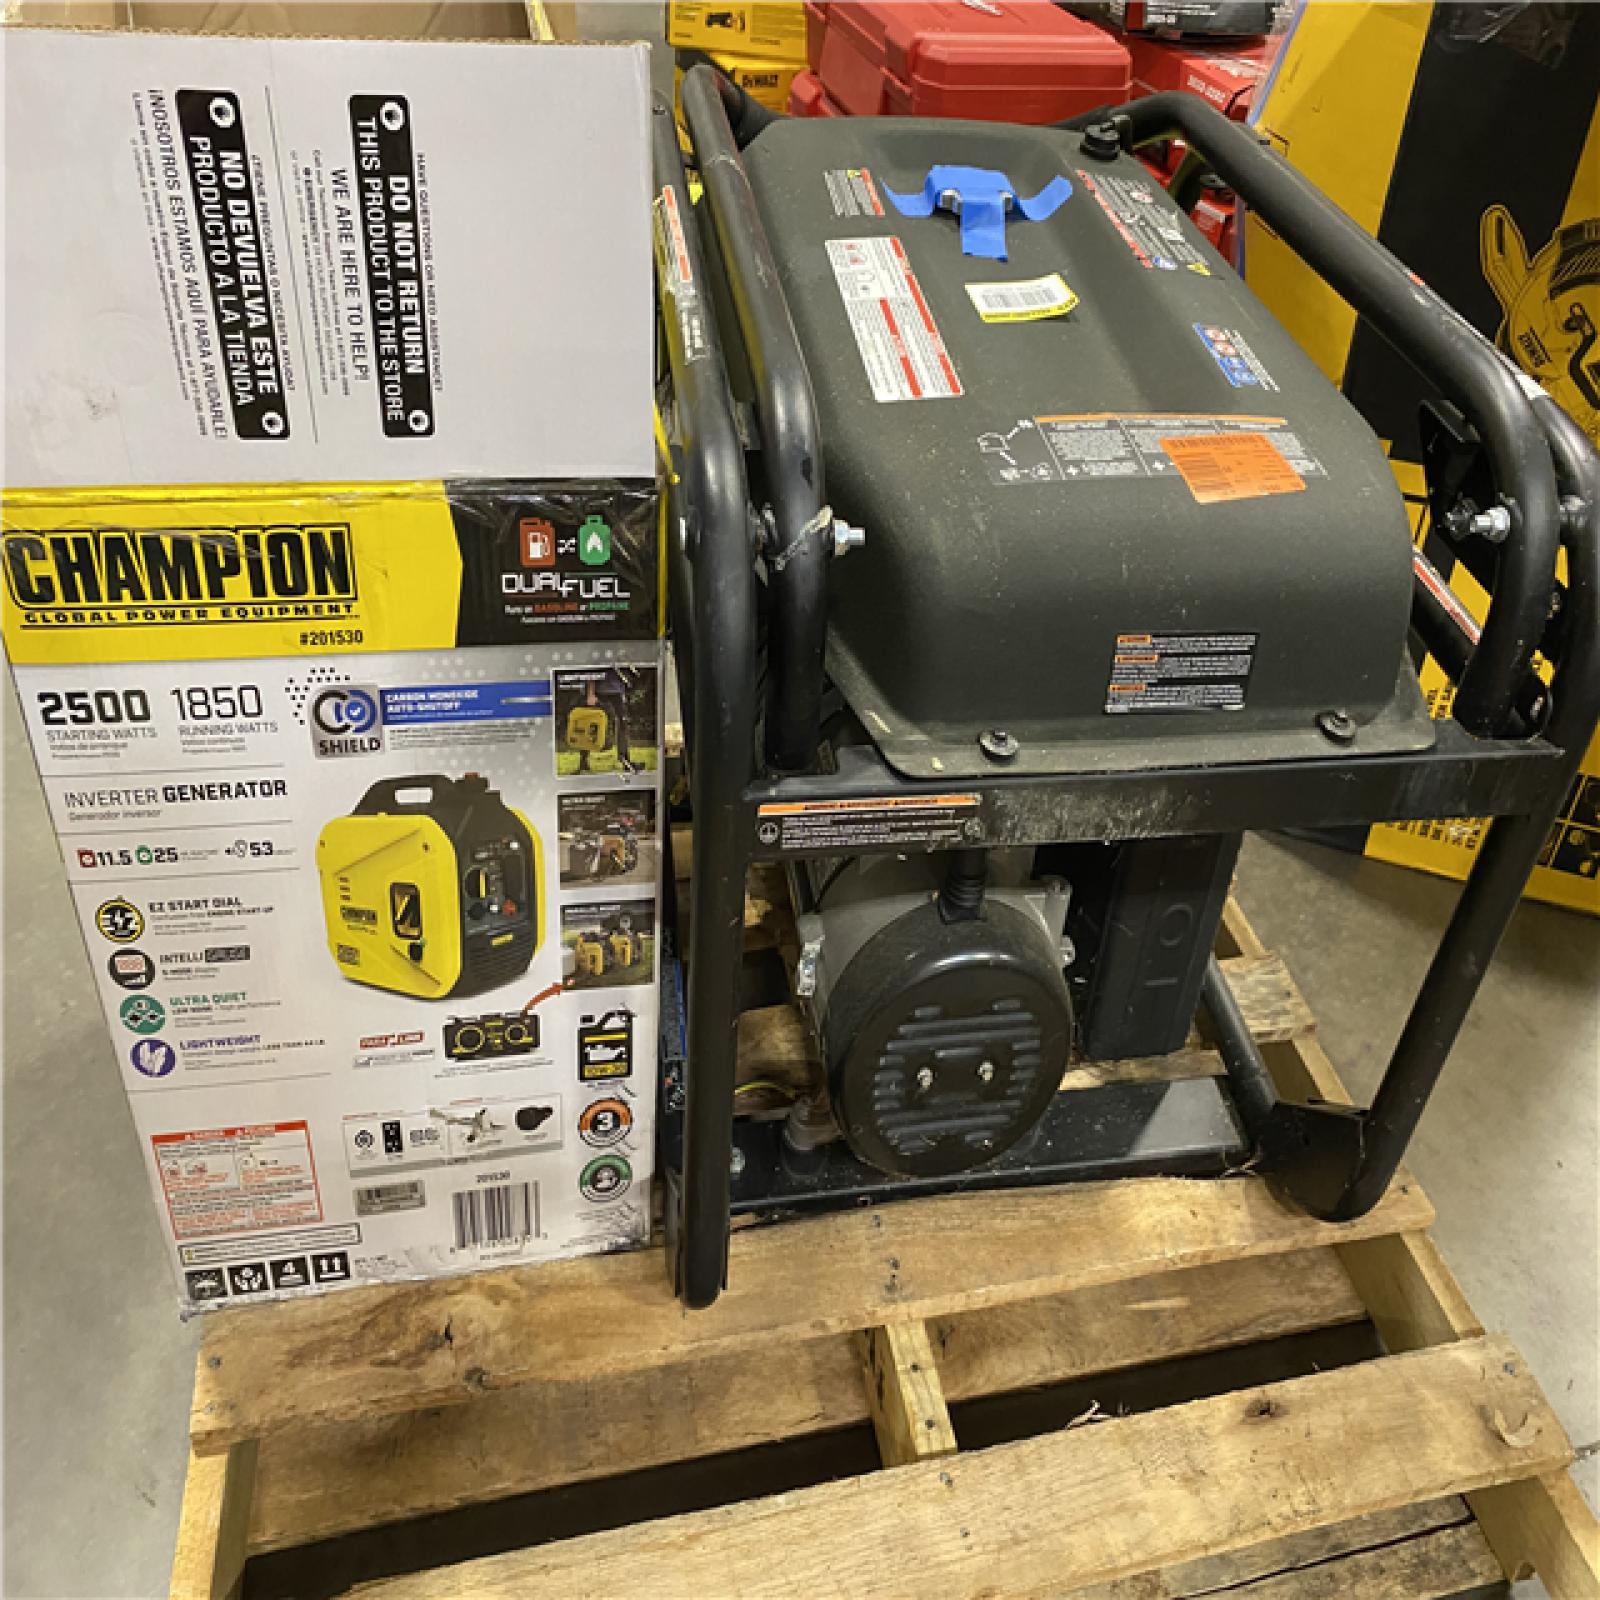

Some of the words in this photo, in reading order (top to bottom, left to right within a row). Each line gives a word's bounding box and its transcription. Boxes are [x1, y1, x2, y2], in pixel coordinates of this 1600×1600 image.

[356, 117, 378, 170] THIS
[219, 151, 245, 190] NO
[329, 168, 352, 199] WE
[416, 153, 425, 186] HAVE
[189, 136, 230, 266] PRODUCTO
[389, 176, 410, 212] DO
[167, 196, 197, 273] ESTAMOS
[334, 205, 356, 244] ARE
[361, 177, 388, 280] PRODUCT
[418, 190, 432, 261] QUESTIONS
[227, 199, 267, 329] DEVUELVA
[392, 221, 415, 272] NOT
[213, 272, 233, 288] A
[339, 249, 360, 297] HERE
[424, 265, 433, 280] OR
[183, 277, 206, 316] AQUÍ
[218, 294, 240, 323] LA
[345, 305, 364, 326] TO
[374, 285, 393, 312] TO
[426, 284, 436, 314] NEED
[190, 319, 210, 359] PARA
[376, 316, 397, 356] THE
[398, 280, 424, 375] RETURN
[223, 330, 254, 406] TIENDA
[250, 336, 277, 394] ESTE
[348, 332, 369, 381] HELP!
[199, 362, 227, 440] AYUDARLE!
[381, 359, 404, 422] STORE
[4, 525, 354, 607] CHAMPION
[24, 609, 117, 624] GLOBAL
[126, 608, 209, 622] POWER
[221, 603, 354, 620] EQUIPMENT
[300, 629, 364, 646] #201530
[37, 689, 151, 726] 2500
[169, 684, 263, 721] 1850
[46, 729, 110, 742] STARTING
[114, 727, 157, 740] WATTS
[178, 724, 234, 737] RUNNING
[235, 721, 278, 734] WATTS
[318, 739, 381, 756] SHIELD
[64, 787, 158, 808] INVERTER
[163, 779, 288, 803] GENERATOR
[96, 851, 132, 866] 11.5
[154, 848, 179, 863] 25
[249, 841, 274, 856] 53
